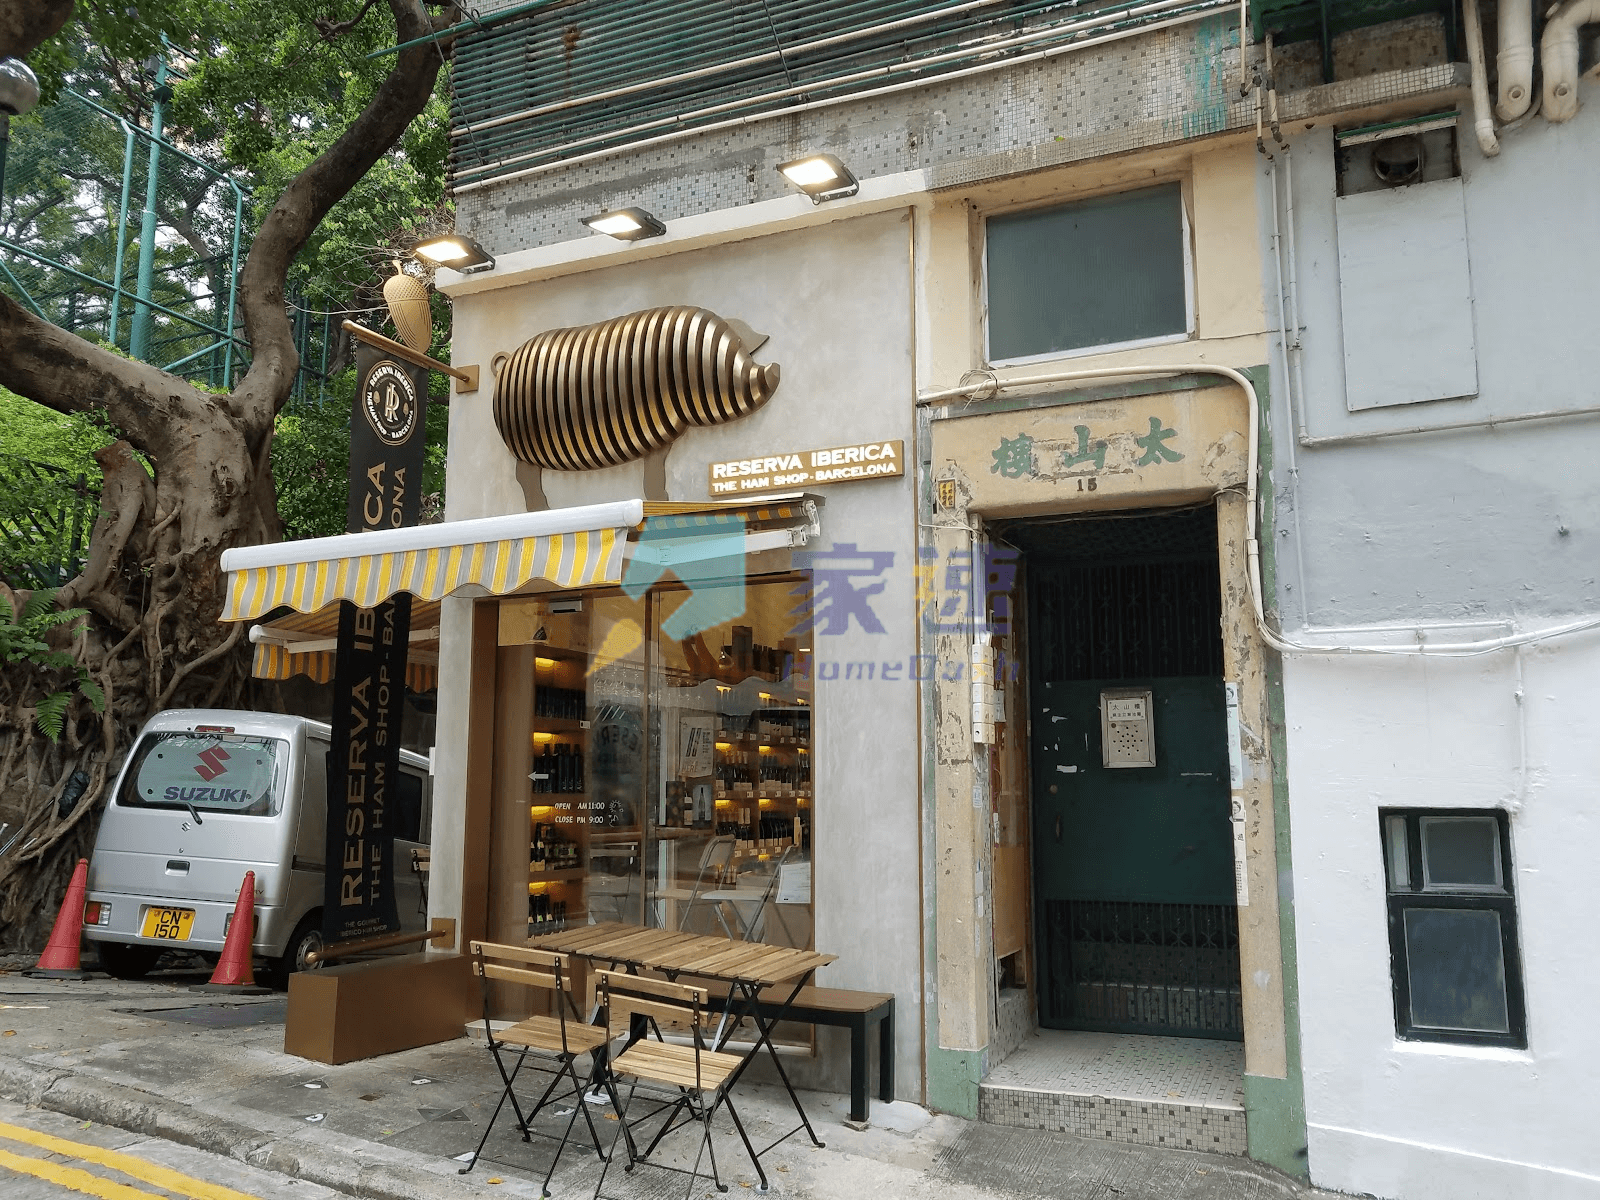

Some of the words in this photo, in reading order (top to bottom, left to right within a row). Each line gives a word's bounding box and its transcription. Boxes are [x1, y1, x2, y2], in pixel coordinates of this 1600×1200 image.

[369, 366, 394, 387] RESERVA
[712, 454, 803, 479] RESERVA
[811, 443, 896, 468] IBERICA
[712, 481, 737, 492] THE
[741, 477, 769, 489] HAM
[773, 472, 808, 486] SHOP
[815, 462, 896, 481] BARCELONA
[1076, 478, 1098, 492] 15
[376, 666, 390, 747] SHOP
[163, 786, 248, 803] SUZUKI
[340, 675, 372, 907] RESERVA
[373, 762, 386, 829] HAM
[554, 802, 571, 810] OPEN
[588, 816, 604, 824] 9:00
[371, 845, 381, 906] THE
[160, 909, 181, 924] CN
[153, 924, 179, 939] 150
